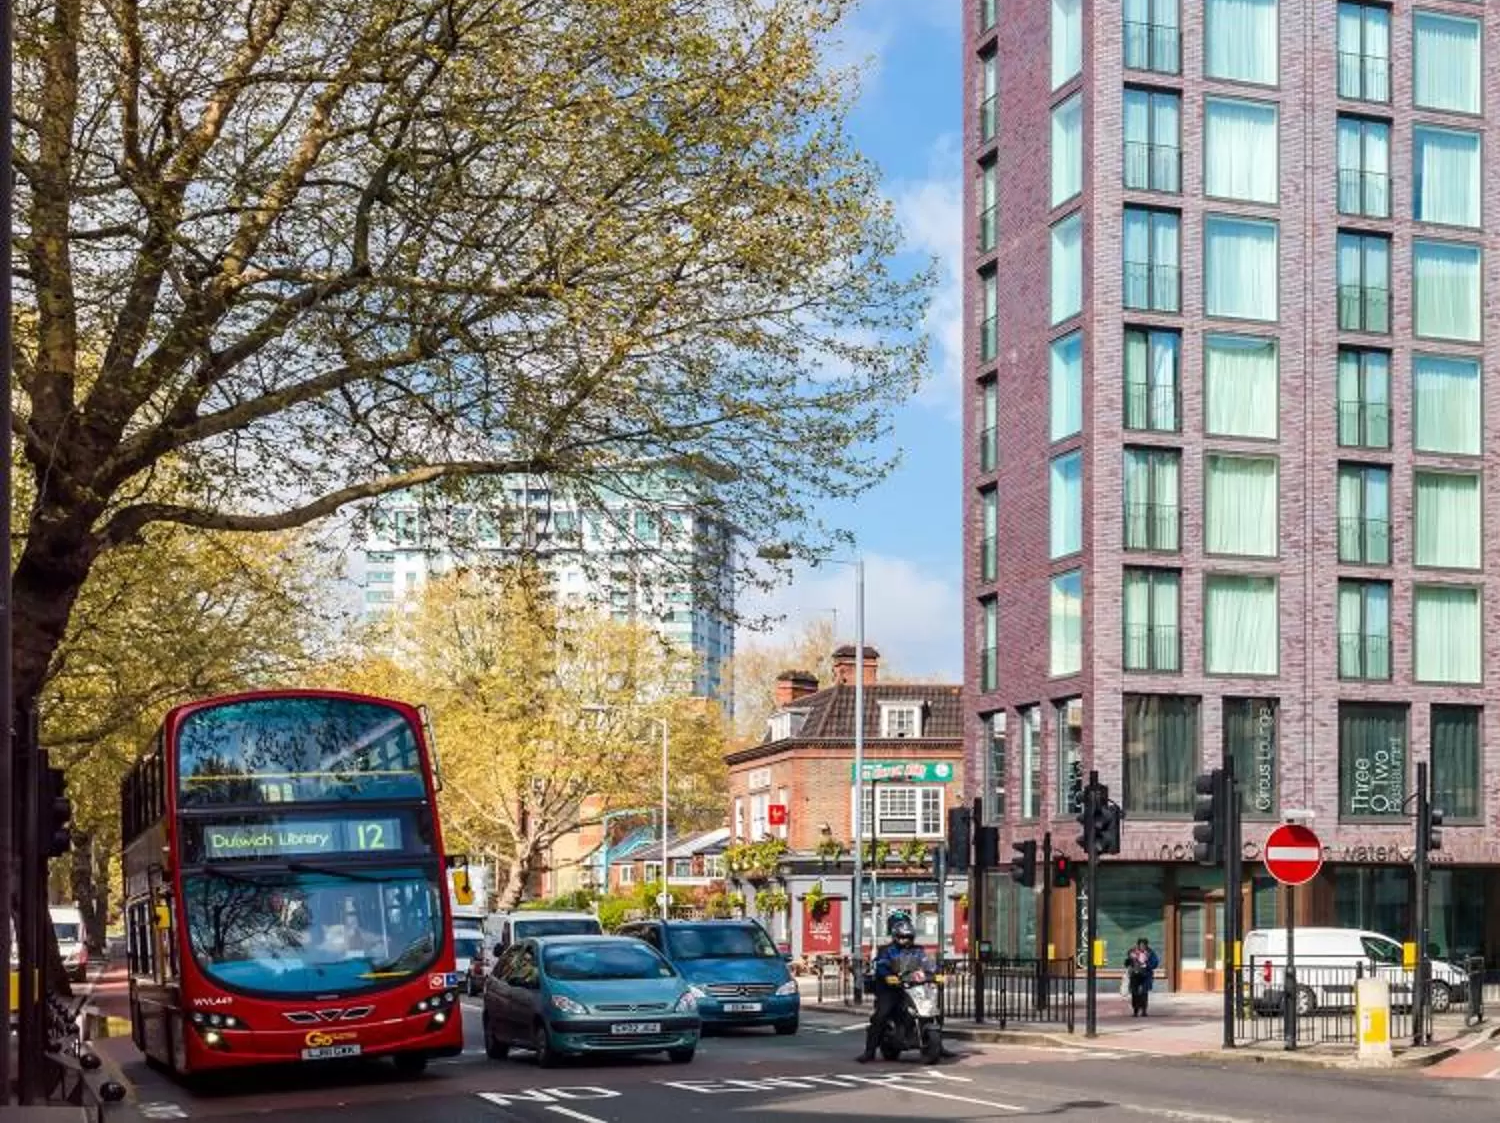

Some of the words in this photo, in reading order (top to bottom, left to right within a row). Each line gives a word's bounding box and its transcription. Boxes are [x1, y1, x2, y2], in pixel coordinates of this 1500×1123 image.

[1351, 758, 1370, 813] Three
[1371, 750, 1389, 789] Two
[1255, 764, 1271, 810] Circus
[211, 832, 274, 849] Dulwich
[278, 830, 329, 847] Library
[357, 824, 385, 850] 12
[1343, 843, 1413, 862] waterlo
[475, 1086, 622, 1106] NO
